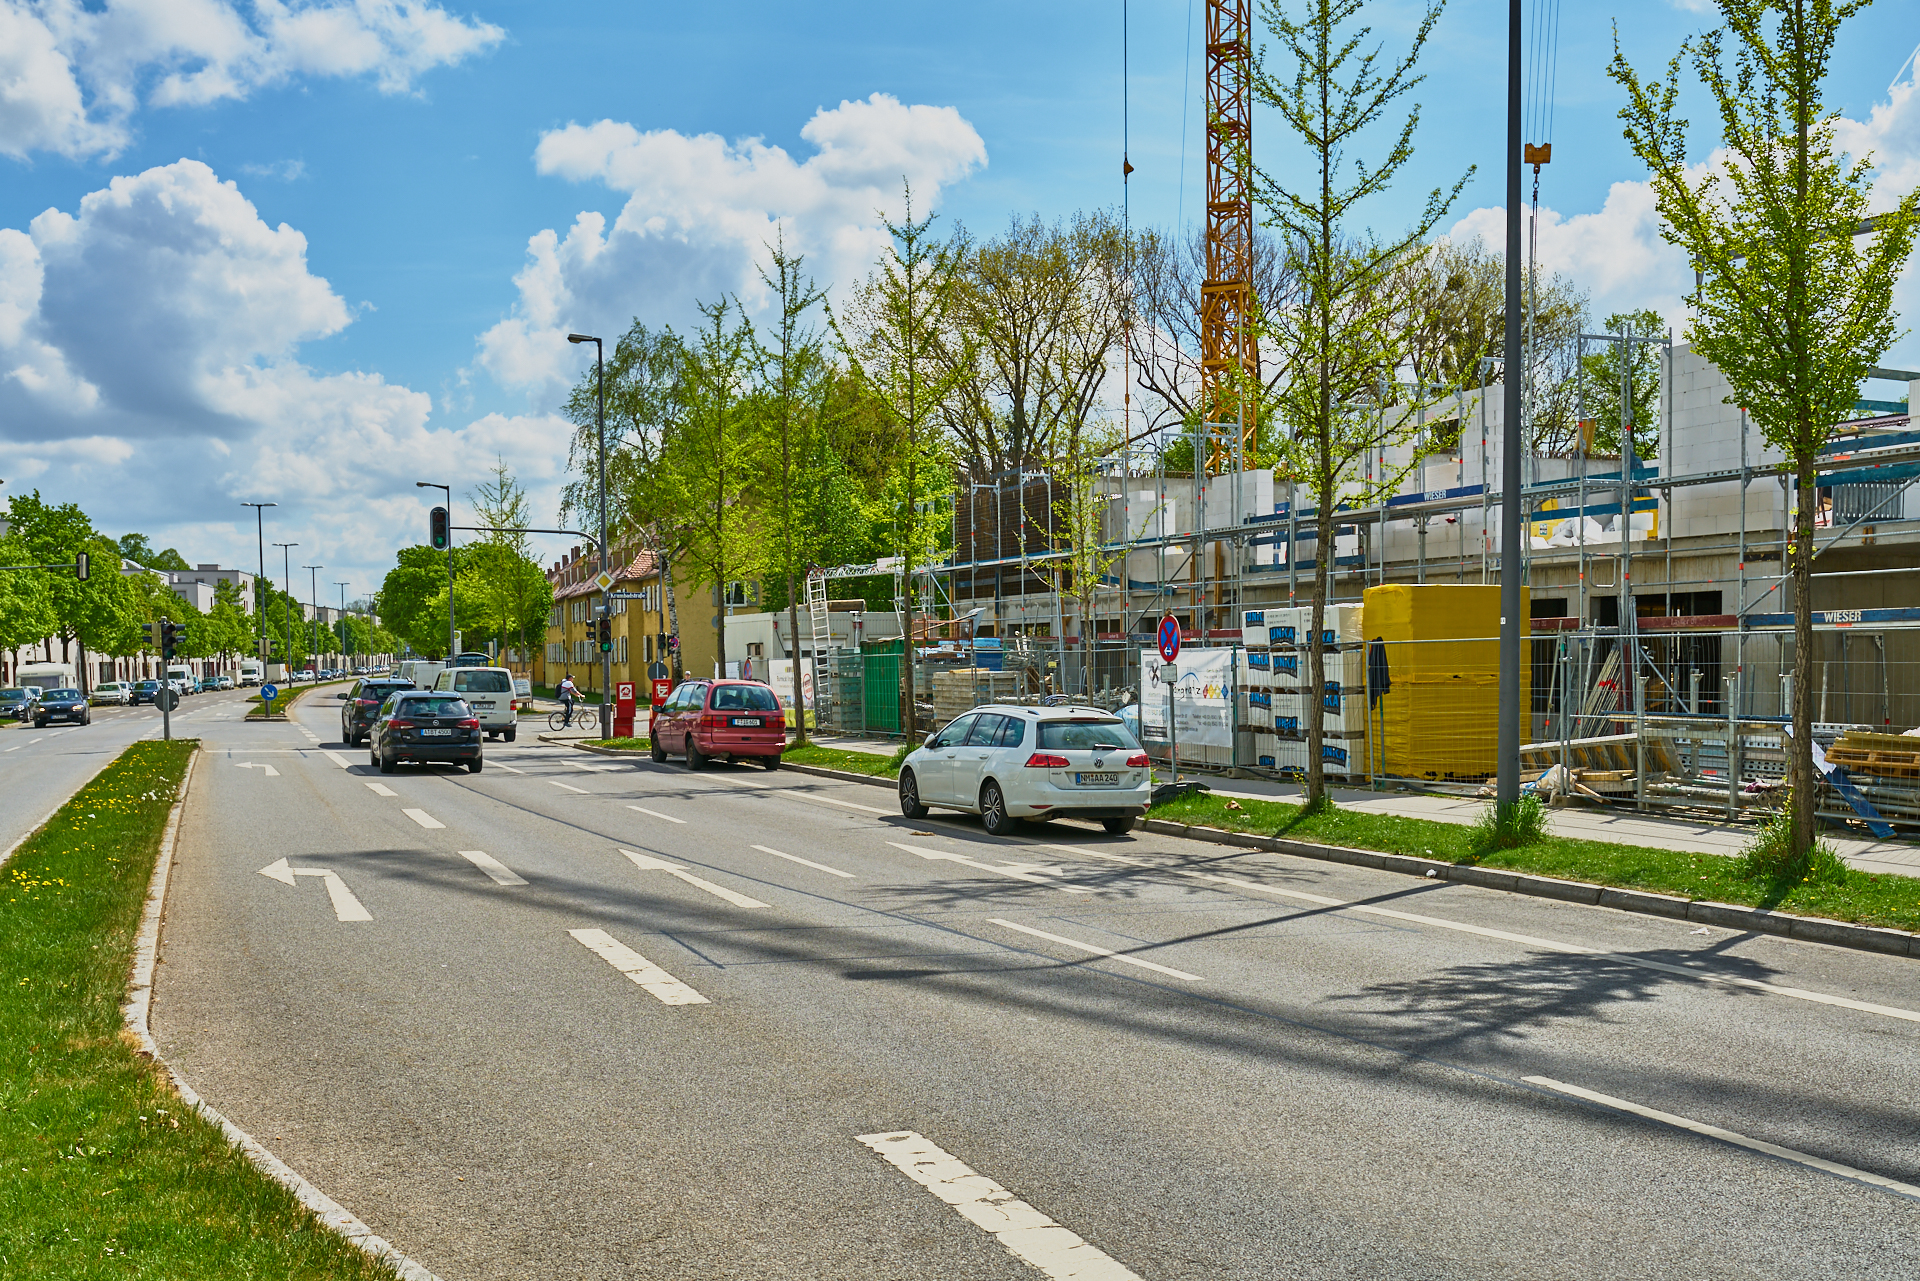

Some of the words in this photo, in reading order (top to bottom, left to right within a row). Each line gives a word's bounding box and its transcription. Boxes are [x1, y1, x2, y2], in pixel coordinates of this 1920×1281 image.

[1424, 490, 1446, 501] WIESER
[1824, 611, 1862, 623] WIESER
[1081, 774, 1091, 782] NM
[1094, 774, 1104, 782] AA
[1105, 773, 1118, 782] 240
